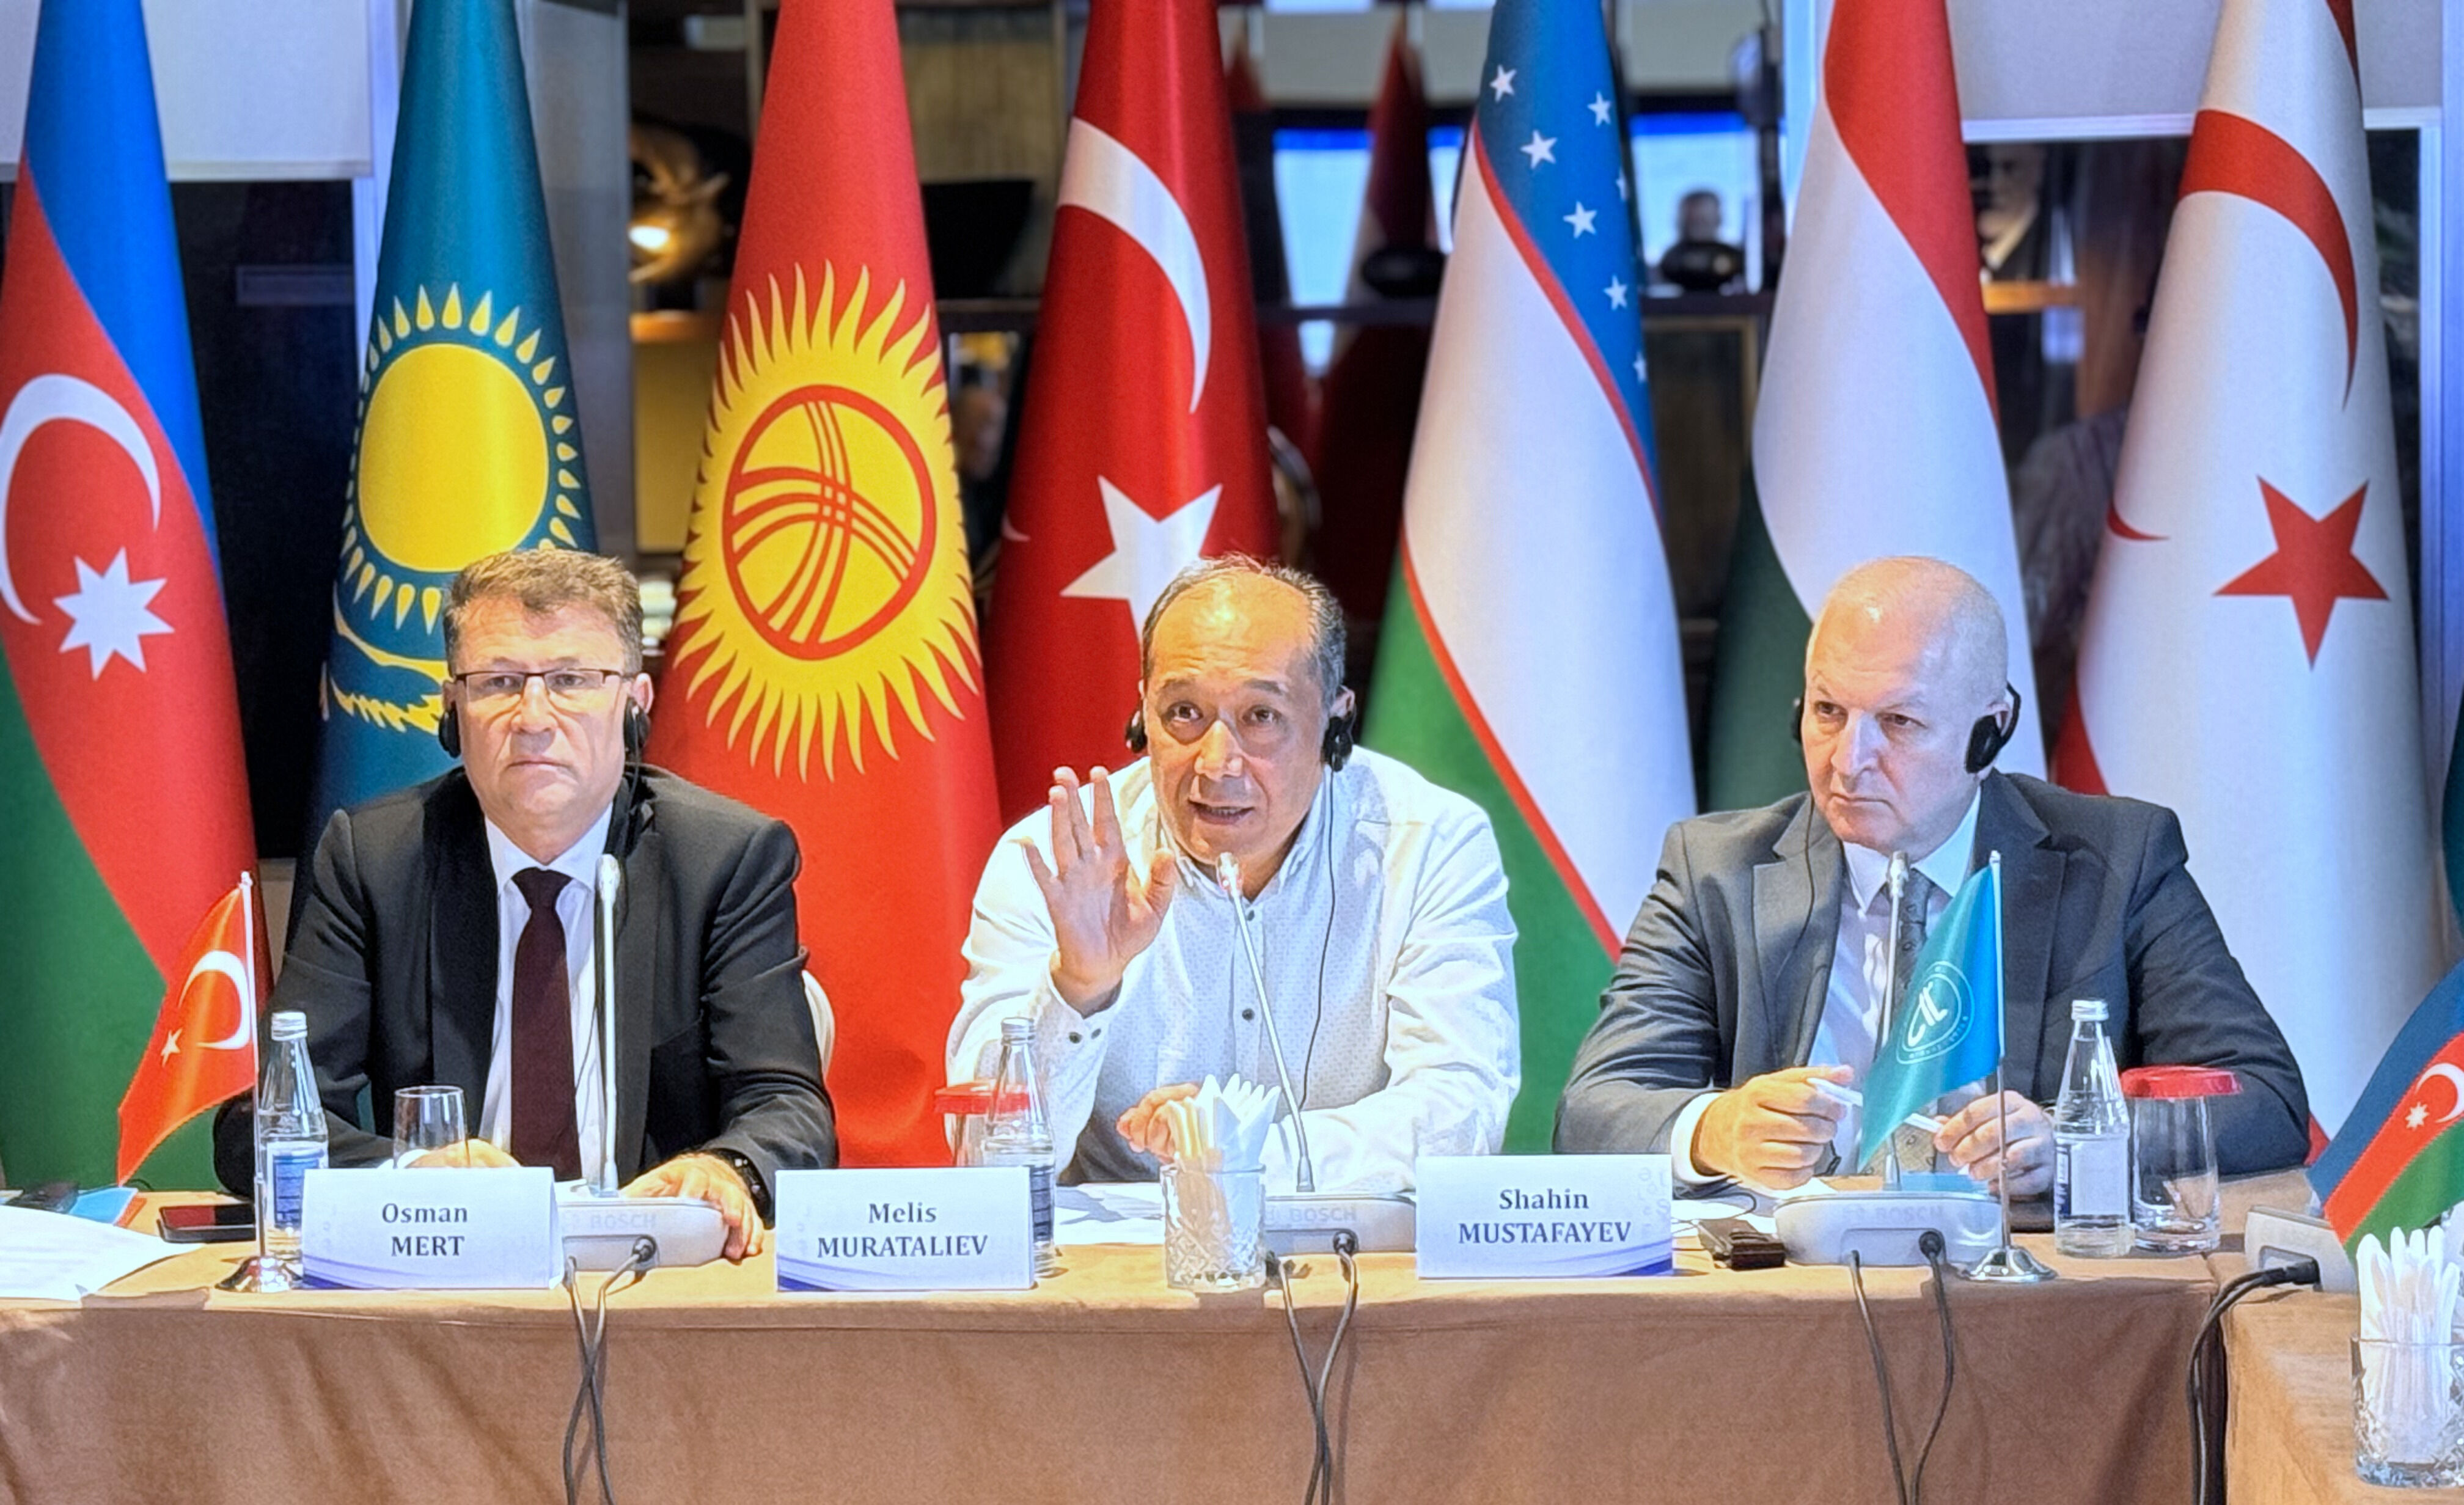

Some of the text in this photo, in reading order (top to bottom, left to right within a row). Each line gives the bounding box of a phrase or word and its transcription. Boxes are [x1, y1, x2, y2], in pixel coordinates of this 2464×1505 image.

[1499, 1188, 1589, 1209] Shahin
[383, 1203, 468, 1223] Osman
[591, 1214, 657, 1229] BOSCH
[868, 1202, 937, 1223] Melis
[1289, 1207, 1356, 1222] BOSCH
[1458, 1221, 1631, 1243] MUSTAFAYEV
[391, 1236, 465, 1256] MERT
[817, 1235, 988, 1258] MURATALIEV
